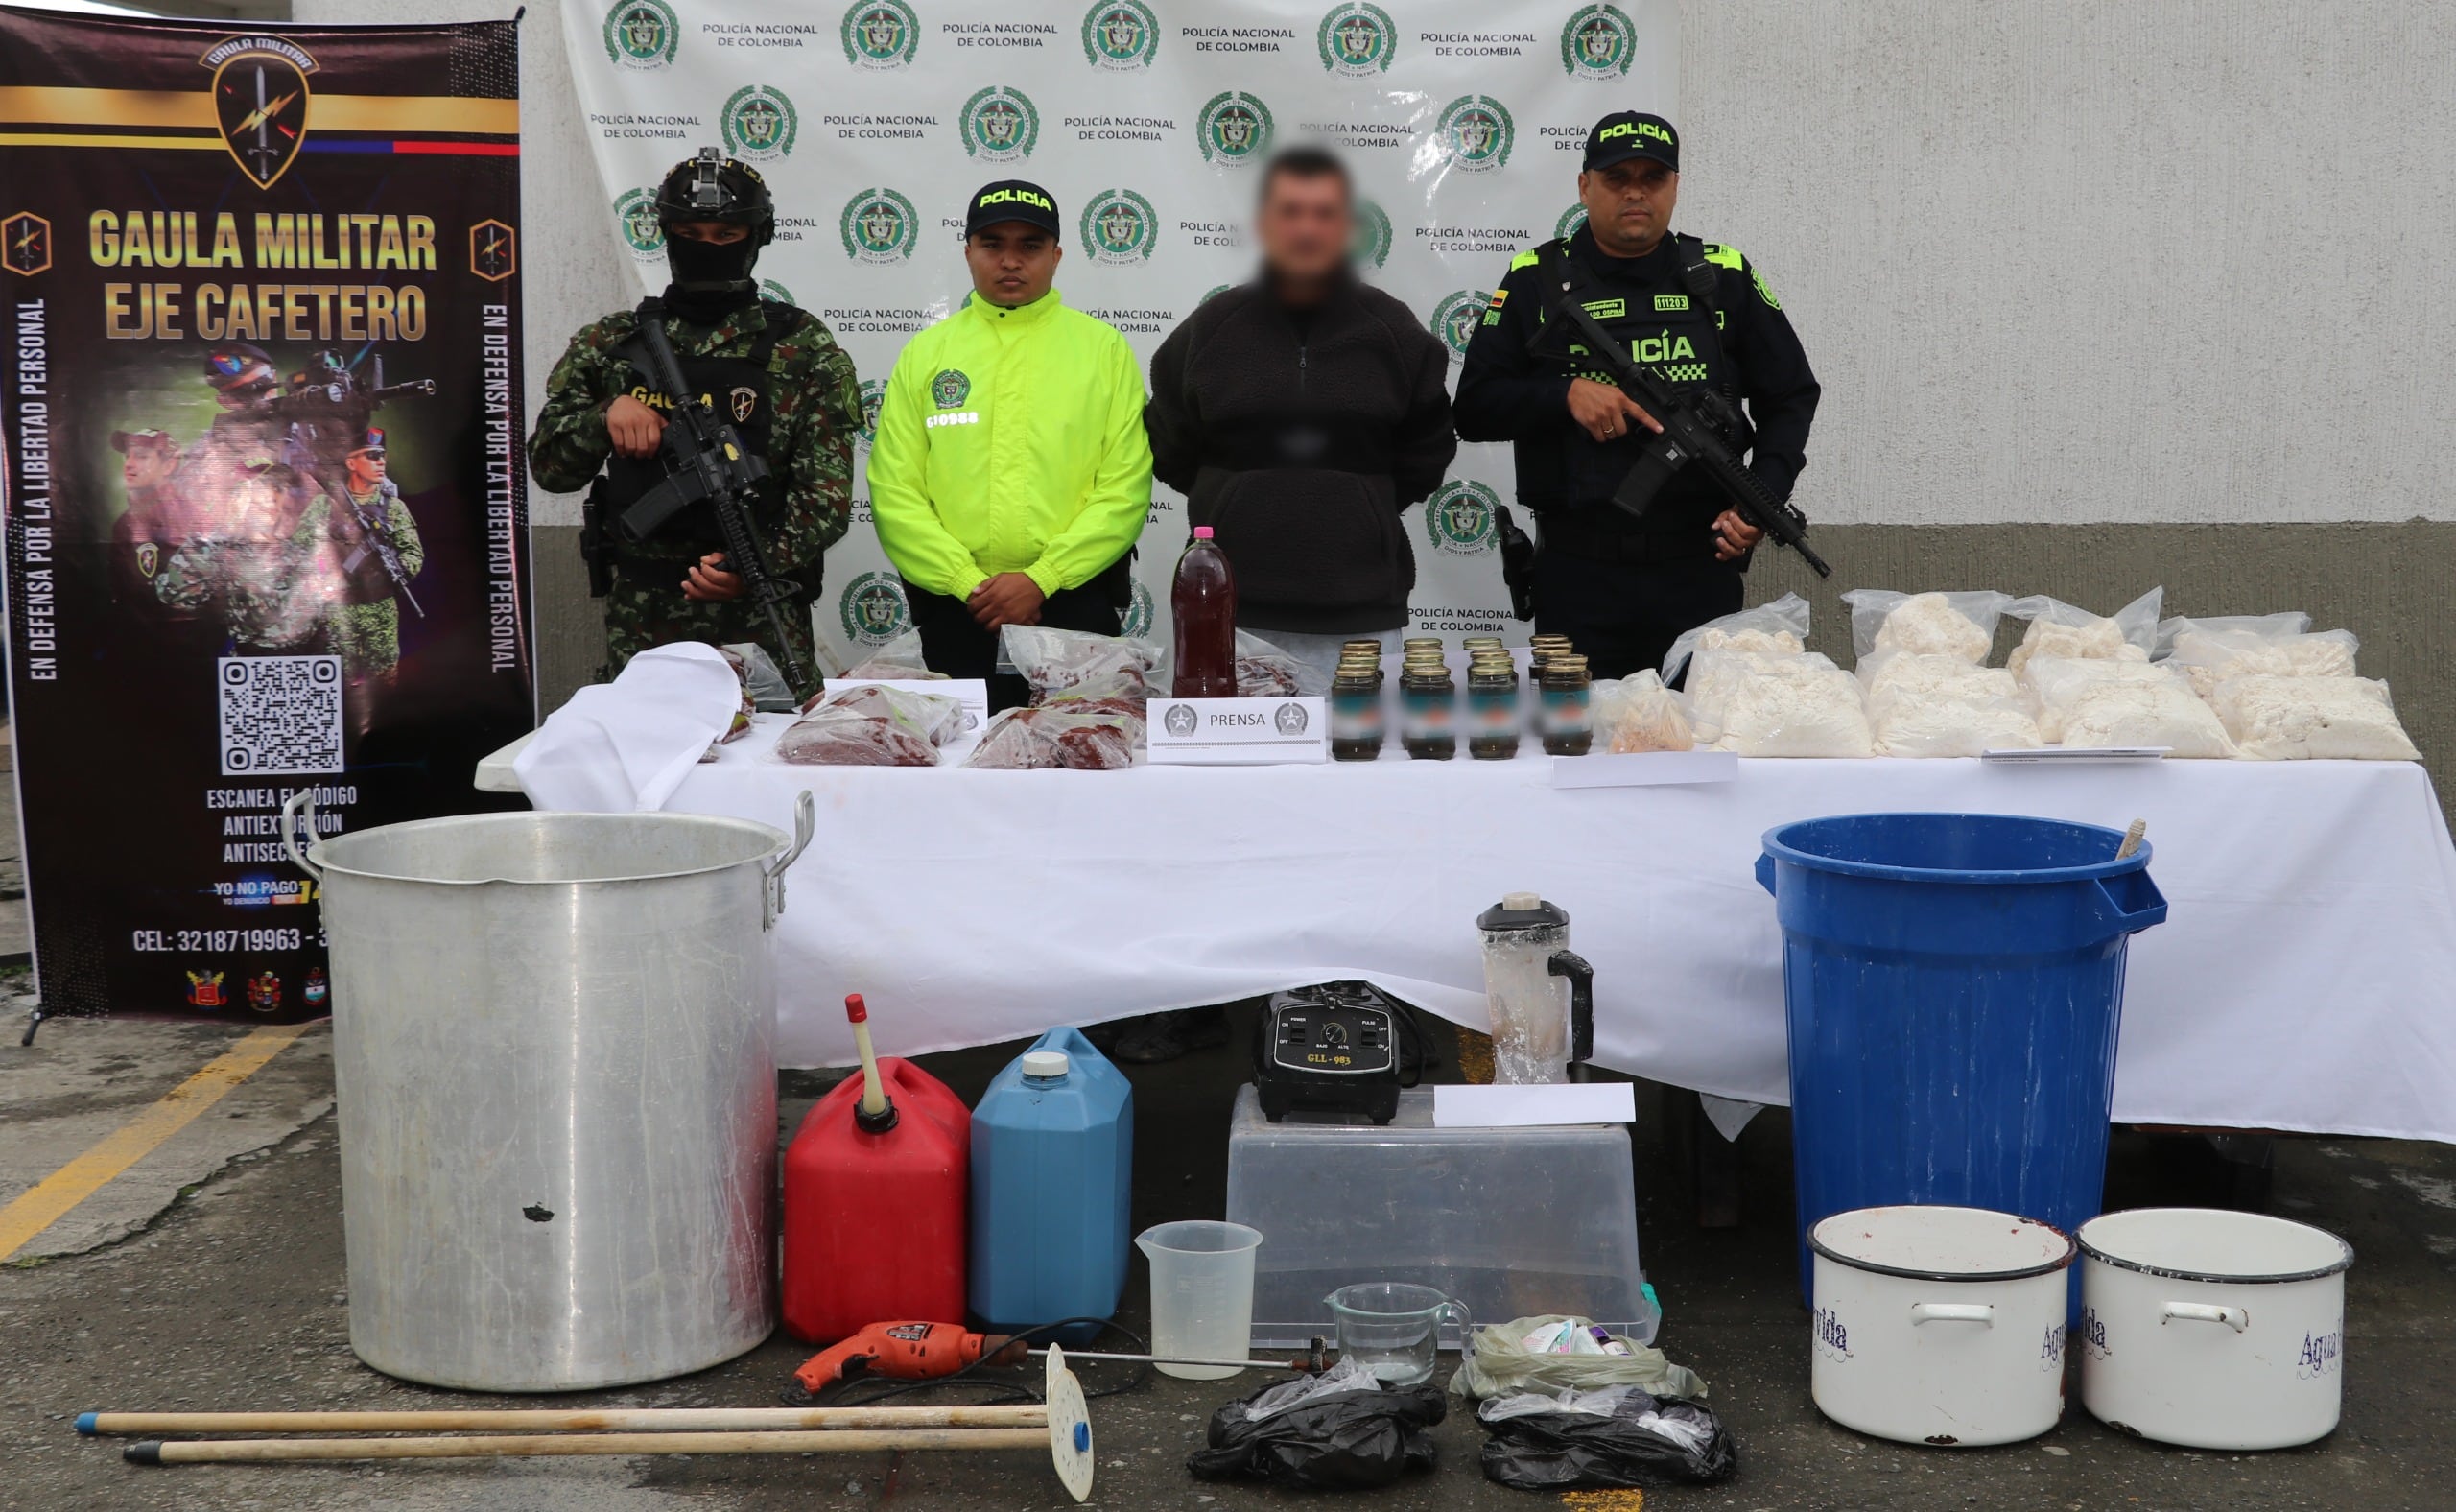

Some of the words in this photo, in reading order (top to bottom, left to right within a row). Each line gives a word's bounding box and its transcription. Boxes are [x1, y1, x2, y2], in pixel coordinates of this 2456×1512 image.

[703, 23, 751, 34] POLICÍA
[756, 25, 817, 34] NACIONAL
[943, 23, 991, 33] POLICÍA
[995, 24, 1057, 34] NACIONAL
[1183, 28, 1228, 36] POLICÍA
[1233, 29, 1295, 37] NACIONAL
[718, 37, 734, 46] DE
[738, 38, 803, 47] COLOMBIA
[1421, 33, 1469, 42] POLICÍA
[1474, 34, 1536, 42] NACIONAL
[1197, 42, 1212, 51] DE
[1216, 42, 1280, 52] COLOMBIA
[1436, 47, 1452, 56] DE
[1455, 47, 1521, 56] COLOMBIA
[207, 38, 252, 64] GAULA
[255, 38, 313, 68] MILITAR
[591, 113, 634, 124] POLICÍA
[638, 116, 700, 125] NACIONAL
[824, 115, 872, 125] POLICÍA
[876, 116, 938, 125] NACIONAL
[1065, 115, 1111, 127] POLICÍA
[1116, 117, 1176, 129] NACIONAL
[604, 130, 620, 138] DE
[623, 129, 686, 138] COLOMBIA
[839, 130, 855, 138] DE
[859, 130, 924, 138] COLOMBIA
[1351, 125, 1414, 133] NACIONAL
[1541, 126, 1587, 136] POLICÍA
[1600, 123, 1673, 144] POLICÍA
[1079, 131, 1094, 140] DE
[1098, 130, 1162, 141] COLOMBIA
[1555, 141, 1570, 150] DE
[980, 189, 1051, 211] POLICÍA
[1180, 222, 1226, 232] POLICÍA
[1416, 227, 1463, 237] POLICÍA
[1468, 229, 1530, 238] NACIONAL
[89, 210, 243, 269] GAULA
[255, 213, 437, 271] MILITAR
[1194, 236, 1209, 245] DE
[1430, 242, 1447, 251] DE
[1451, 243, 1515, 252] COLOMBIA
[1658, 298, 1686, 307] 111203
[105, 283, 183, 340] EJE
[196, 284, 426, 341] CAFETERO
[484, 305, 507, 327] EN
[825, 308, 871, 319] POLICÍA
[1113, 311, 1174, 320] NACIONAL
[839, 323, 856, 332] DE
[860, 323, 923, 332] COLOMBIA
[17, 298, 46, 395] PERSONAL
[484, 334, 508, 413] DEFENSA
[485, 420, 510, 454] POR
[21, 403, 50, 490] LIBERTAD
[486, 461, 510, 483] LA
[24, 497, 50, 519] LA
[487, 489, 512, 574] LIBERTAD
[25, 527, 52, 562] POR
[27, 569, 55, 650] DEFENSA
[1408, 606, 1452, 617] POLICÍA
[489, 581, 514, 673] PERSONAL
[1422, 622, 1436, 630] DE
[1440, 623, 1504, 631] COLOMBIA
[31, 658, 57, 679] EN
[1211, 714, 1265, 726] PRENSA
[207, 789, 275, 808] ESCANEA
[215, 883, 233, 895] YO
[237, 883, 256, 894] NO
[261, 881, 298, 894] PAGO
[133, 931, 173, 951] CEL:
[177, 928, 300, 952] 3218719963
